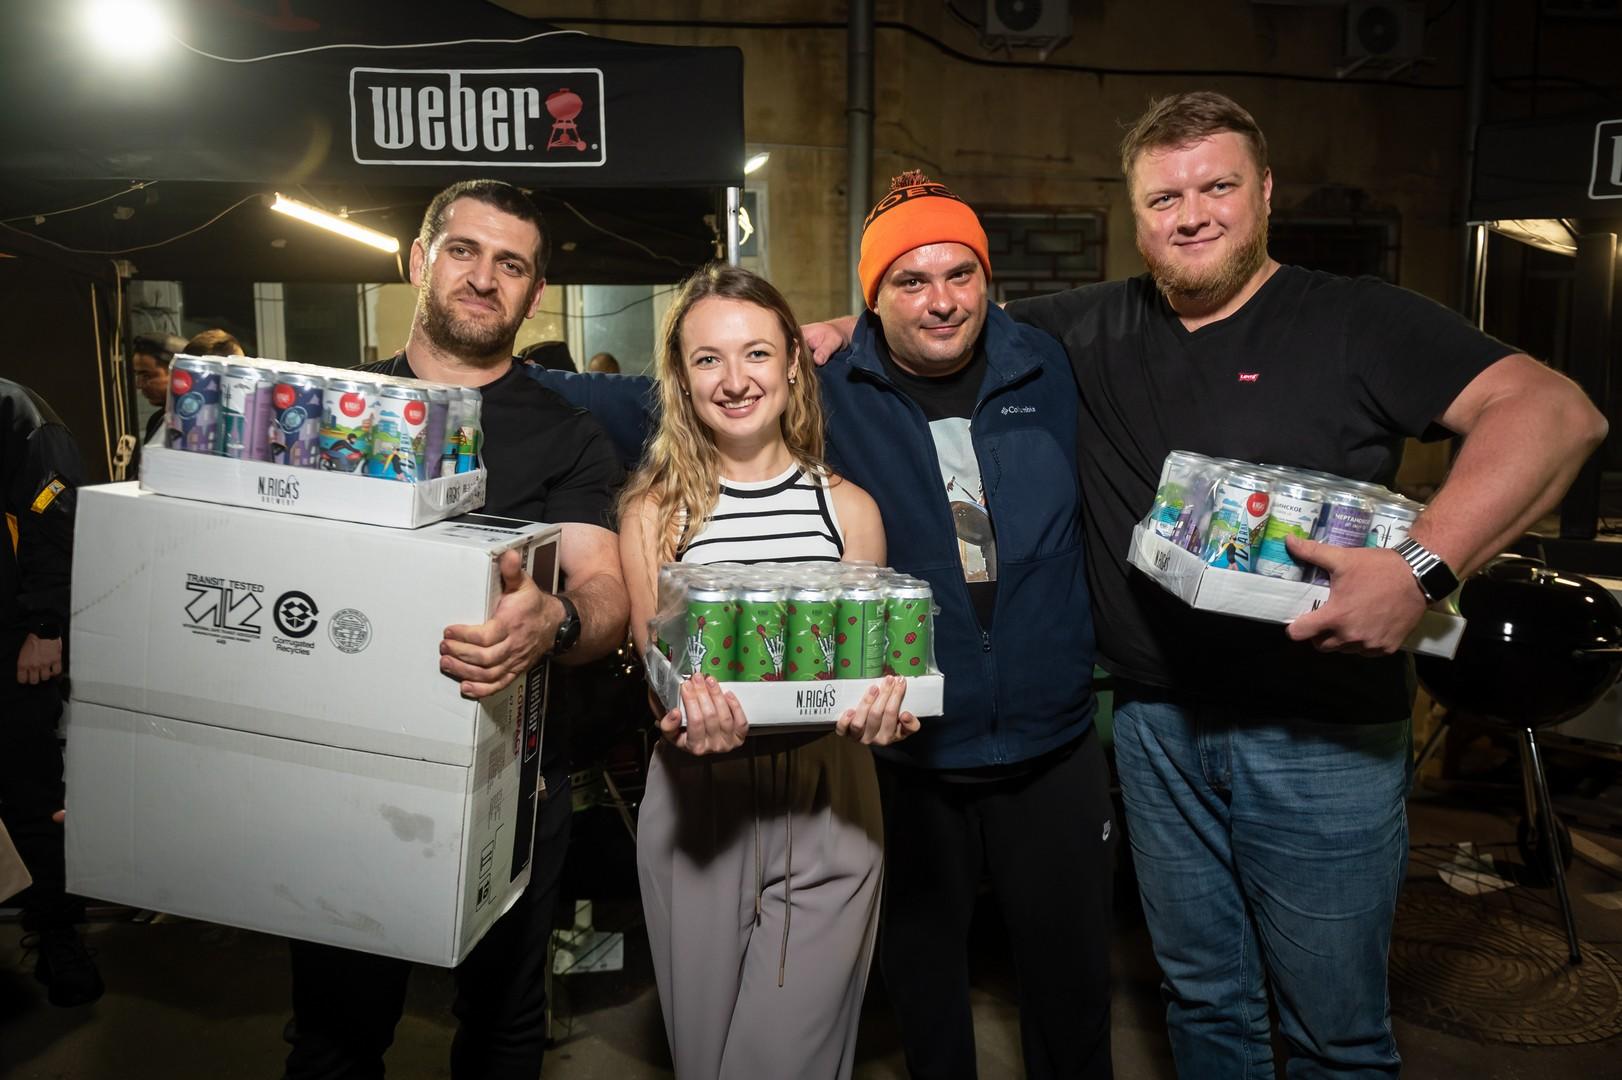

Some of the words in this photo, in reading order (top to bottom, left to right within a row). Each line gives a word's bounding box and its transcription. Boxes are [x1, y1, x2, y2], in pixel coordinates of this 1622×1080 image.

[368, 71, 540, 151] weber
[186, 573, 225, 587] TRANSIT
[229, 580, 264, 593] TESTED
[272, 636, 315, 649] Corrugated
[276, 644, 310, 656] Recycles
